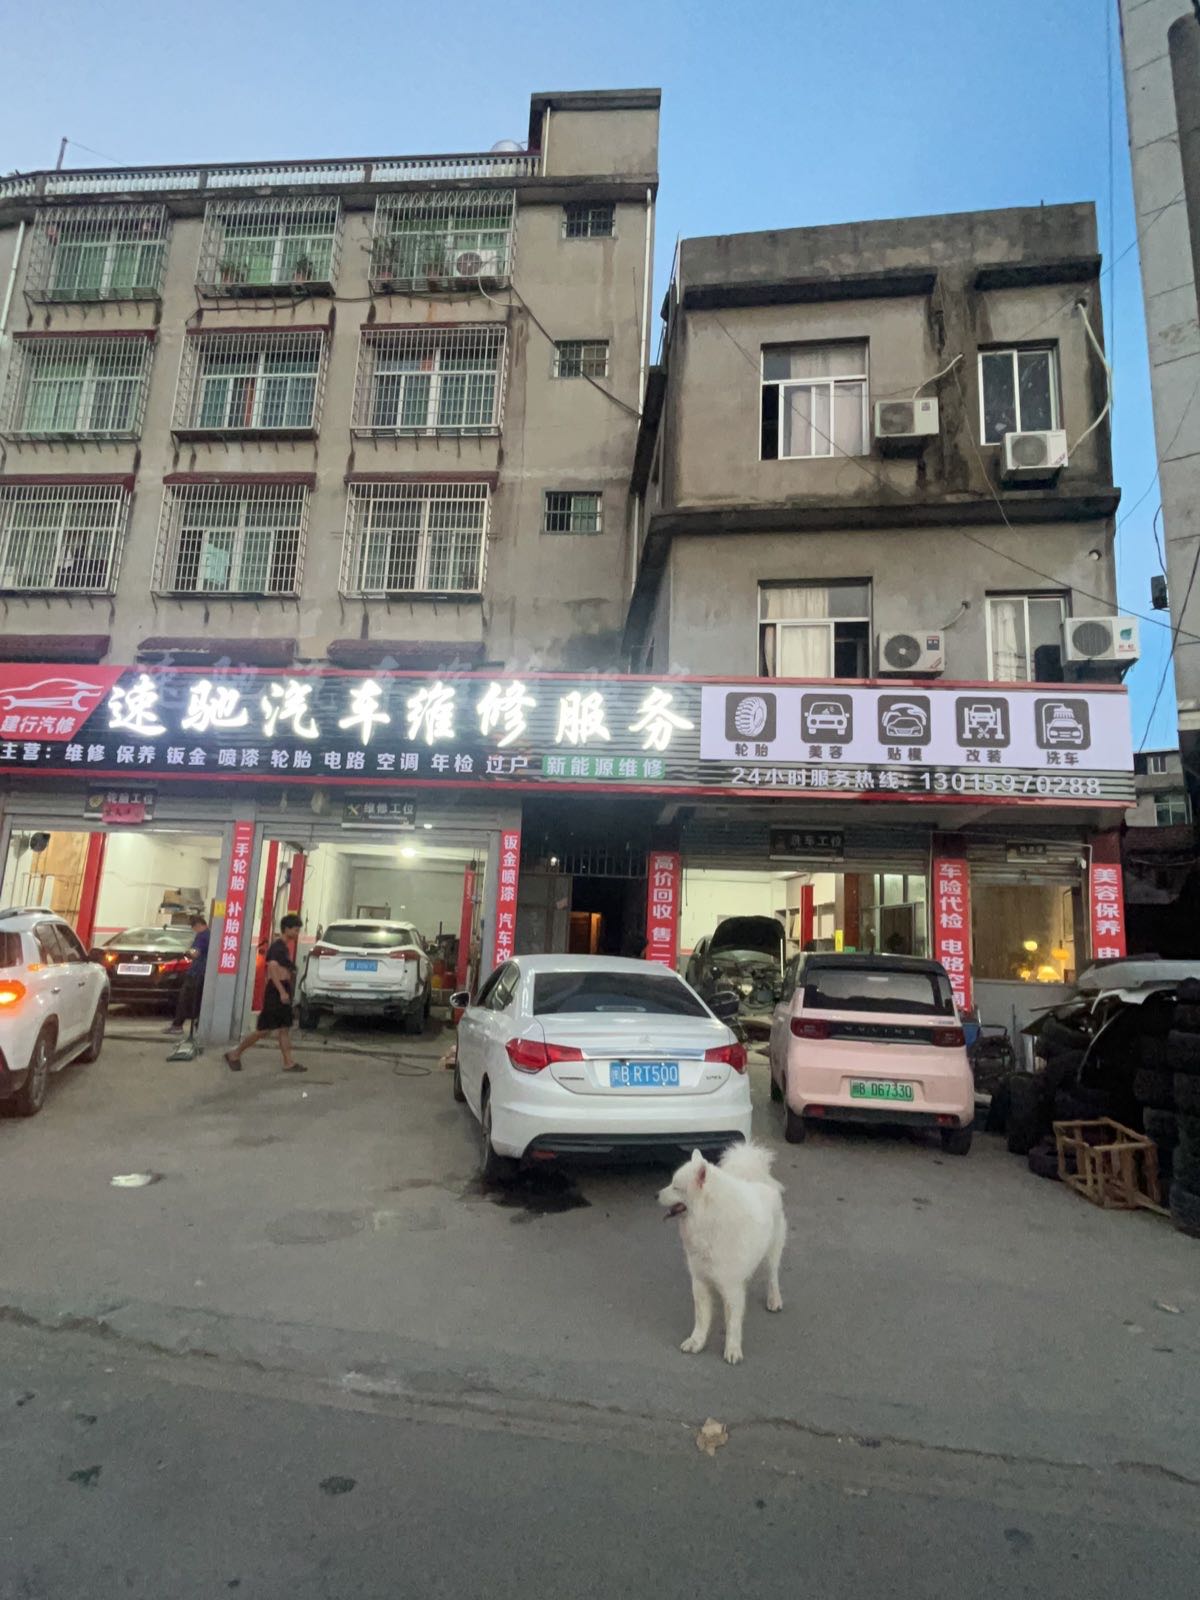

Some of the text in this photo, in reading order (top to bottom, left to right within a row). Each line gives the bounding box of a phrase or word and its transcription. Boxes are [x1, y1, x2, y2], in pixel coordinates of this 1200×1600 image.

[106, 672, 697, 751] 速驰汽车维修服务
[65, 744, 105, 762] 维修
[117, 746, 156, 764] 保养
[167, 747, 207, 766] 钣金
[219, 749, 260, 767] 喷漆
[271, 751, 312, 769] 轮胎
[324, 752, 366, 770] 电路
[377, 753, 420, 771] 空调
[431, 754, 474, 772] 年检
[486, 756, 530, 774] 过户
[547, 757, 664, 779] 新能源维修
[735, 743, 769, 757] 轮胎
[808, 745, 843, 759] 美容
[966, 750, 1001, 763] 改装
[1046, 752, 1079, 765] 洗车
[221, 826, 250, 969] 二手轮胎 补胎换胎
[500, 835, 518, 902] 钣金喷漆
[652, 855, 674, 919] 高价回收
[939, 863, 963, 929] 车险代检
[1094, 868, 1120, 936] 美容保养
